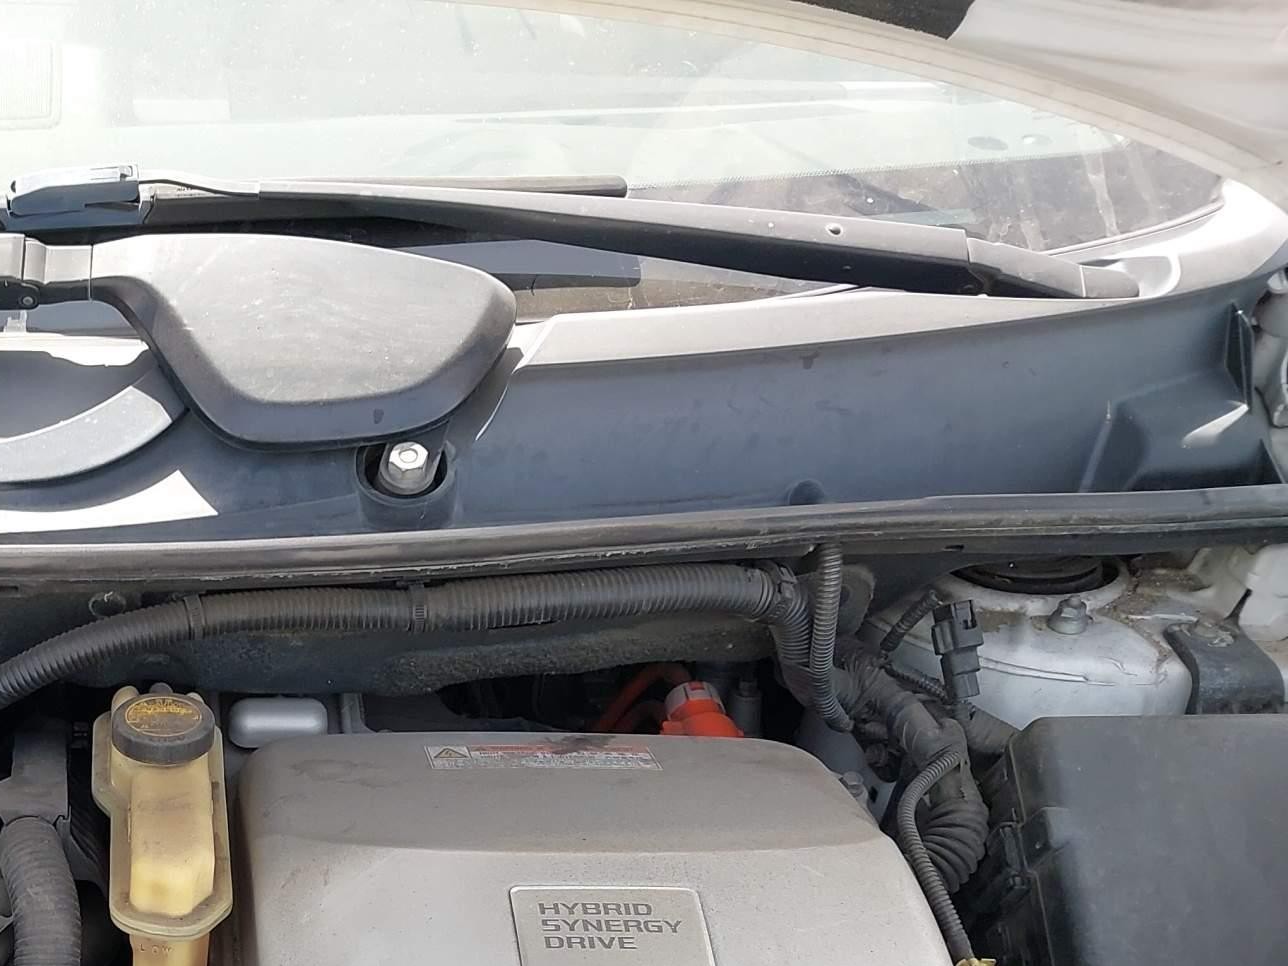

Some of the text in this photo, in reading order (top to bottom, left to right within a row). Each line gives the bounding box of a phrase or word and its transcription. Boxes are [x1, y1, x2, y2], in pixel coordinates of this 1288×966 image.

[538, 902, 652, 916] HYBRID
[541, 919, 682, 933] SYNERGY
[544, 936, 638, 949] DRIVE
